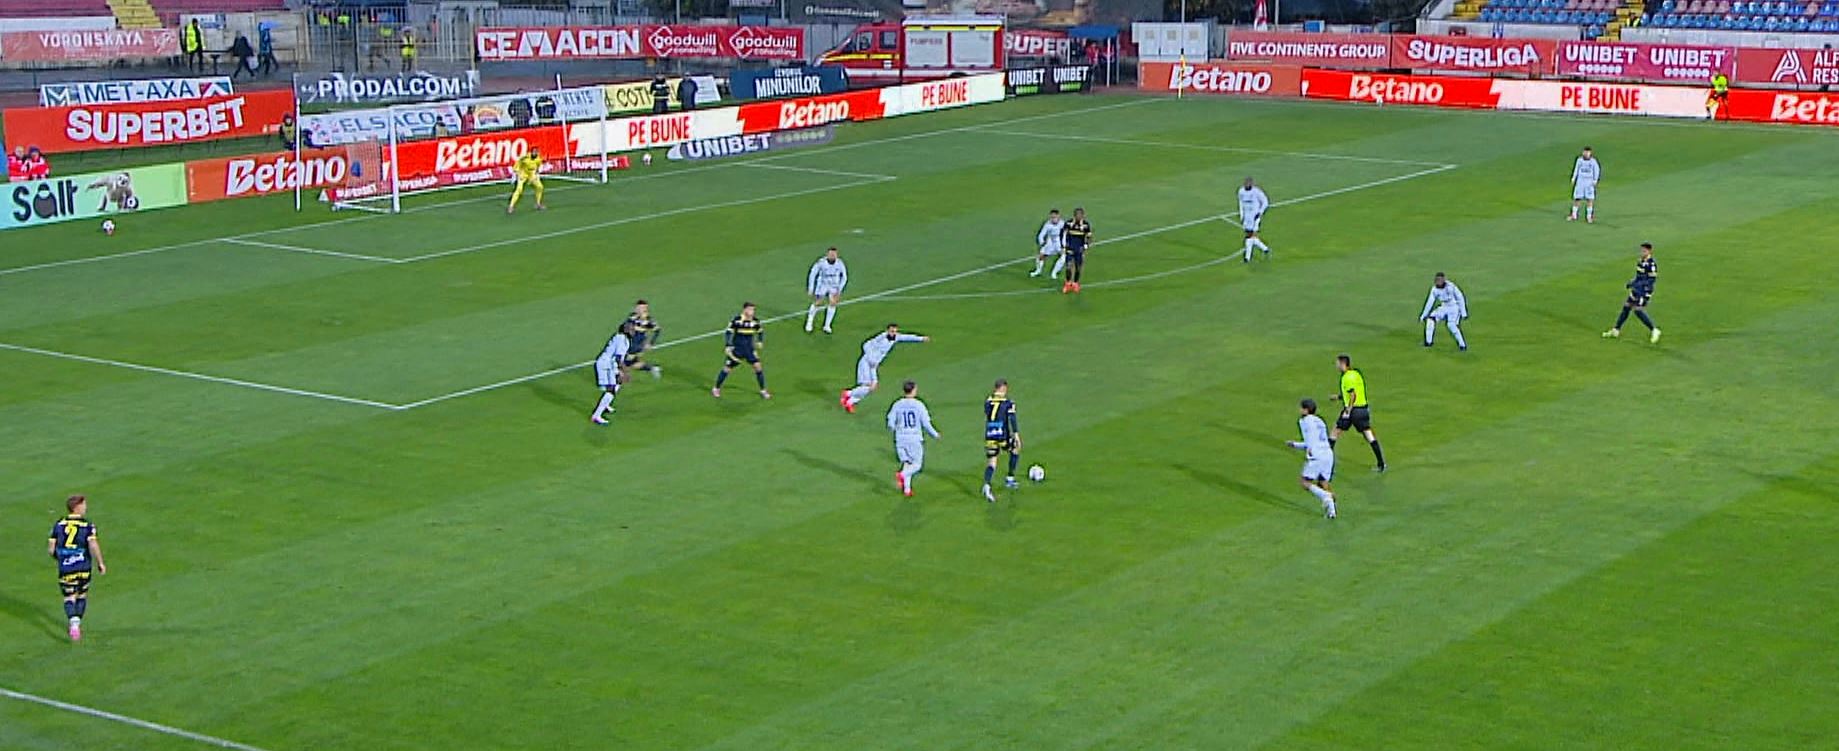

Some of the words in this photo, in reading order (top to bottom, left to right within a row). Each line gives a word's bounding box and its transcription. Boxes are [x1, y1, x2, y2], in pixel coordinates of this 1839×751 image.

[39, 31, 144, 49] VORONSKAYA
[478, 28, 640, 57] CEMACON
[655, 33, 716, 49] goodwill
[736, 35, 797, 50] goodwill
[1230, 42, 1255, 57] FIVE
[1257, 42, 1337, 57] CONTINENTS
[1339, 43, 1386, 58] GROUP
[1408, 40, 1538, 67] SUPERLIGA
[1566, 44, 1638, 64] UNIBET
[1650, 48, 1724, 68] UNIBET
[1009, 68, 1045, 86] UNIBET
[1054, 66, 1089, 83] UNIBET
[1170, 65, 1272, 93] Betano
[85, 80, 194, 103] MET-AXA
[317, 76, 460, 98] PRODALCOM
[755, 76, 821, 99] MINUNILOR
[922, 85, 936, 106] PE
[938, 81, 967, 104] BUNE
[1350, 72, 1443, 102] Betano
[1561, 86, 1583, 107] PE
[1589, 88, 1640, 110] BUNE
[66, 97, 245, 144] SUPERBET
[779, 98, 850, 130] Betano
[629, 120, 646, 146] PE
[650, 116, 691, 142] BUNE
[435, 136, 528, 172] Betano
[686, 132, 773, 158] UNIBET
[226, 154, 346, 196] Betano
[904, 411, 916, 429] 10
[990, 401, 1001, 421] 7
[64, 524, 78, 549] 2
